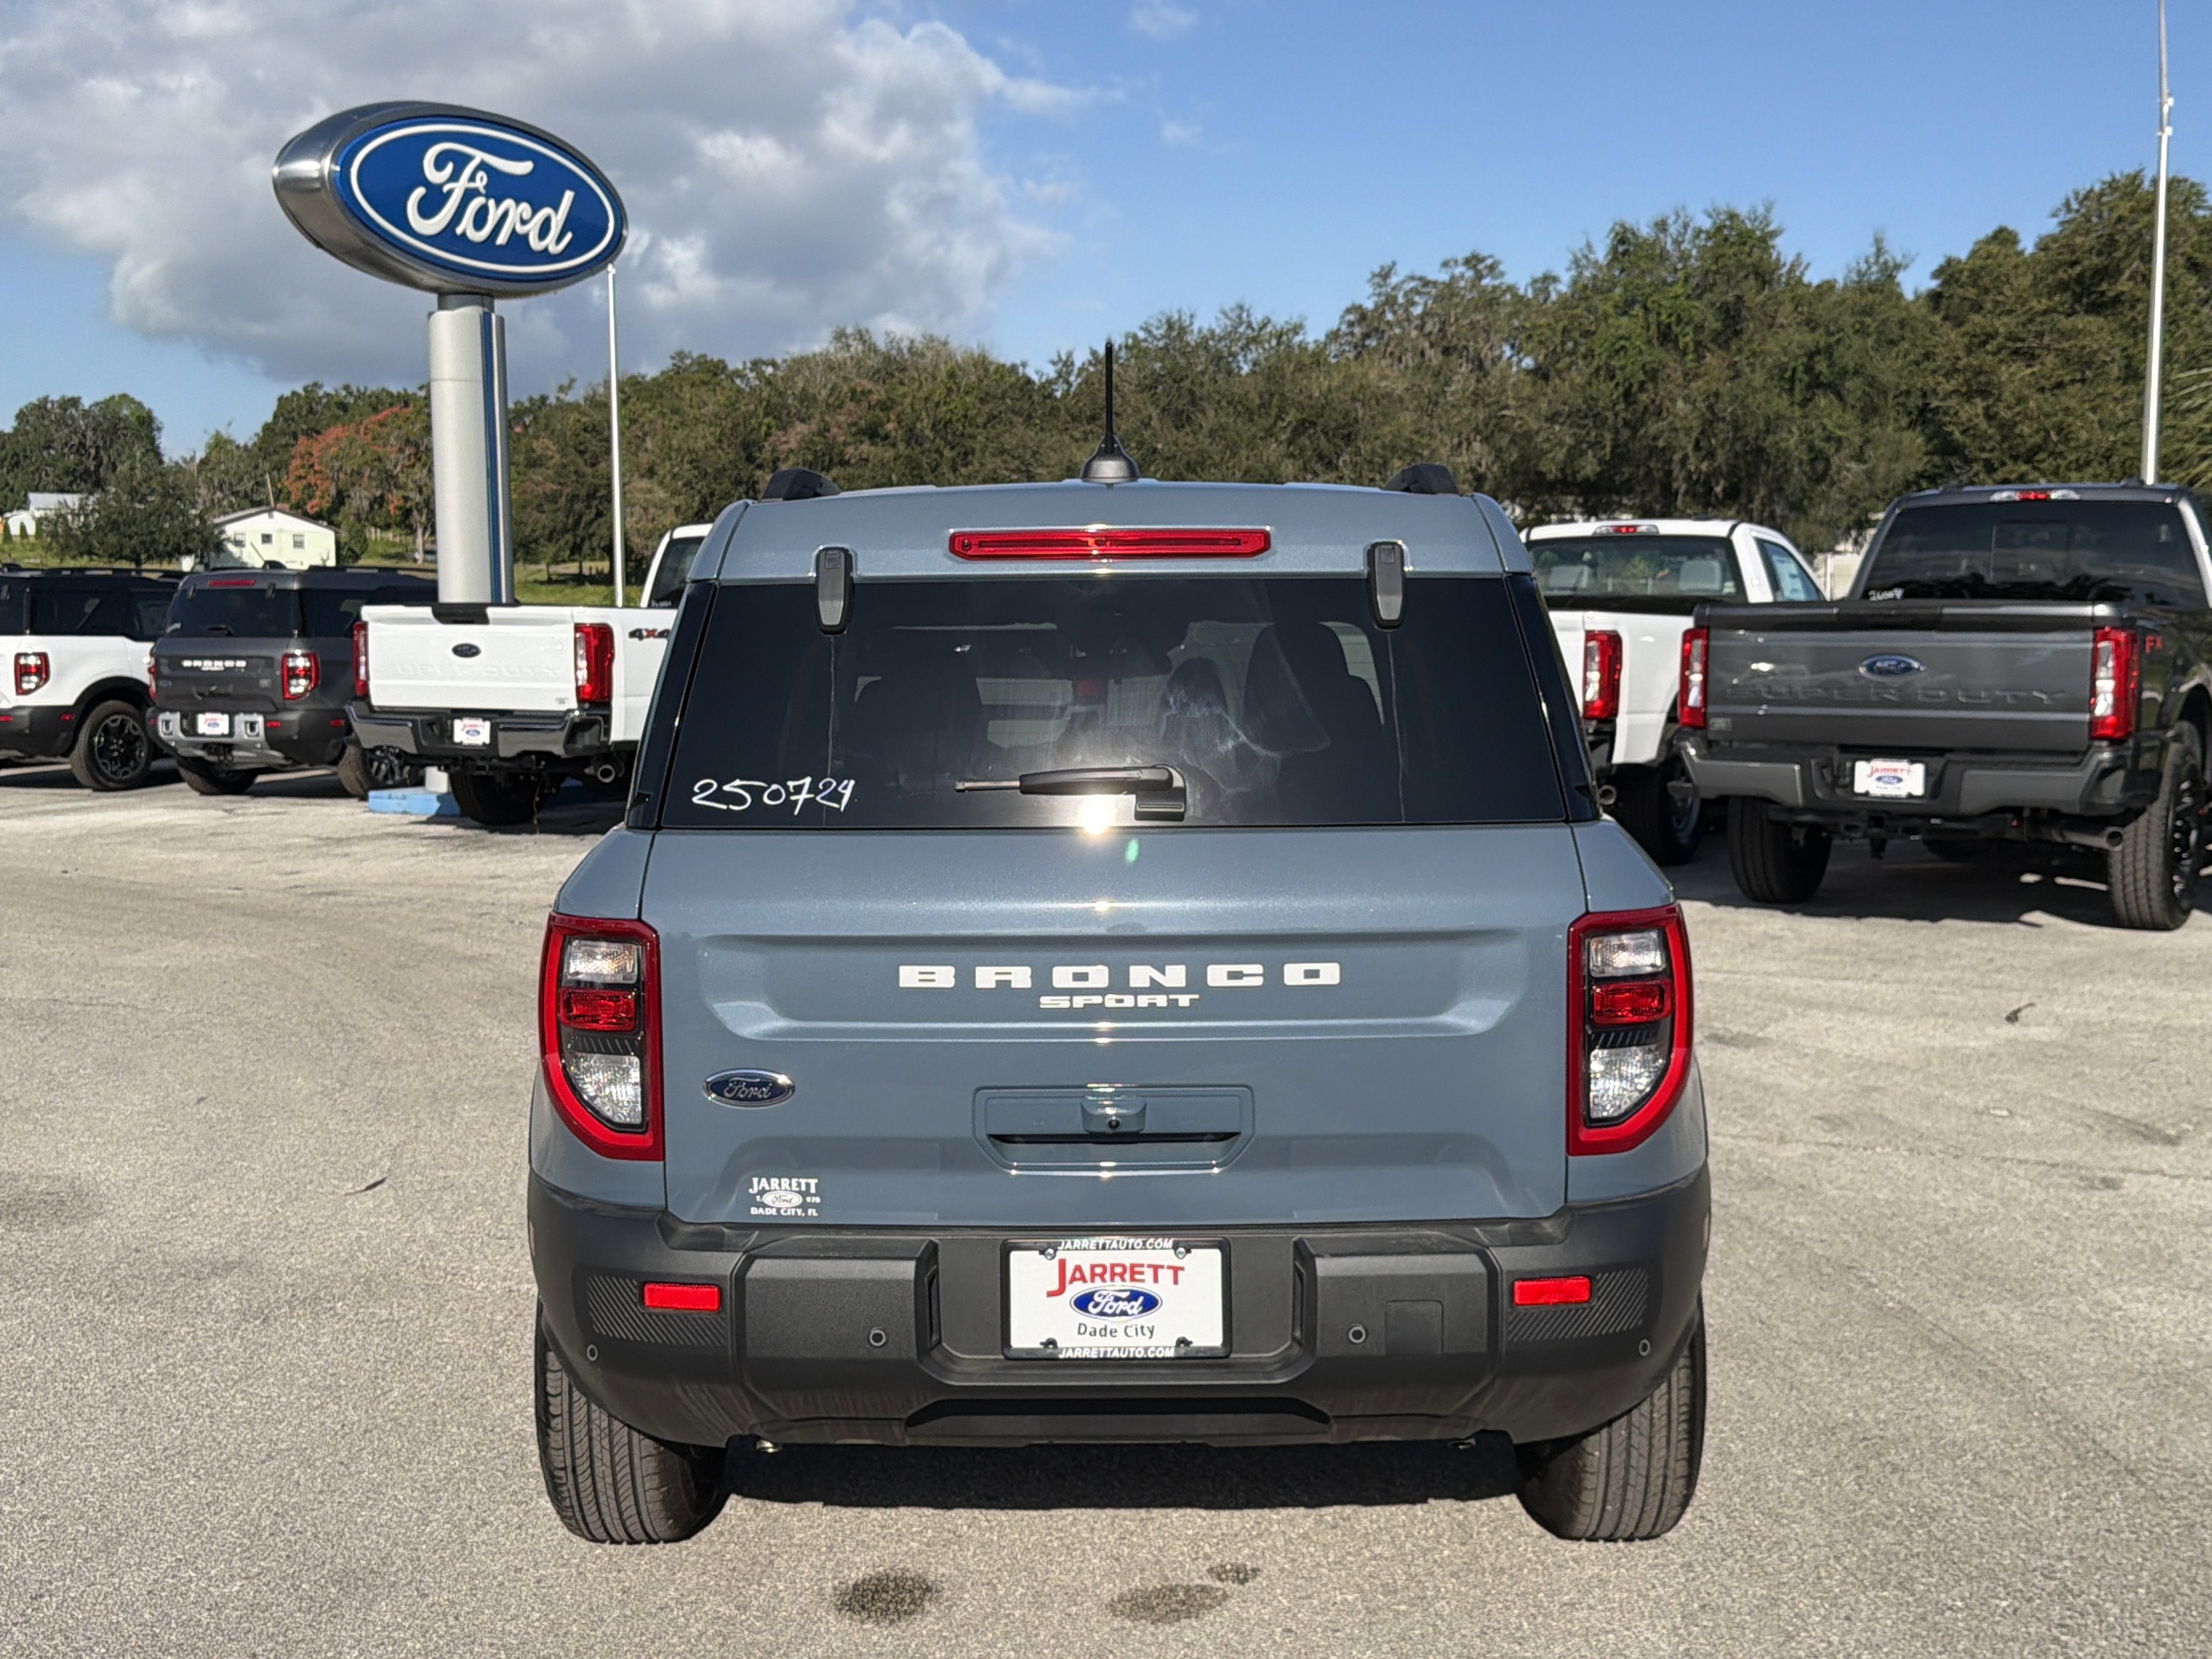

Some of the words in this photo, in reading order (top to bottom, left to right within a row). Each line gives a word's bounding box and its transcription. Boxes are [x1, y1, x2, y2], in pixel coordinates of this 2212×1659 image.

[407, 142, 574, 255] Ford
[899, 962, 1340, 989] BRONCO
[1040, 994, 1200, 1008] SPORT
[724, 1077, 772, 1098] Ford
[748, 1177, 818, 1194] JARRETT
[771, 1194, 794, 1204] Ford
[751, 1207, 778, 1215] DADE
[1058, 1238, 1173, 1250] JARRETTAUTO.COM
[1046, 1258, 1185, 1297] JARRETT
[1088, 1290, 1144, 1315] Ford
[1077, 1323, 1118, 1338] Dade
[1124, 1323, 1155, 1339] City
[1058, 1347, 1175, 1359] JARRETTAUTO.COM
